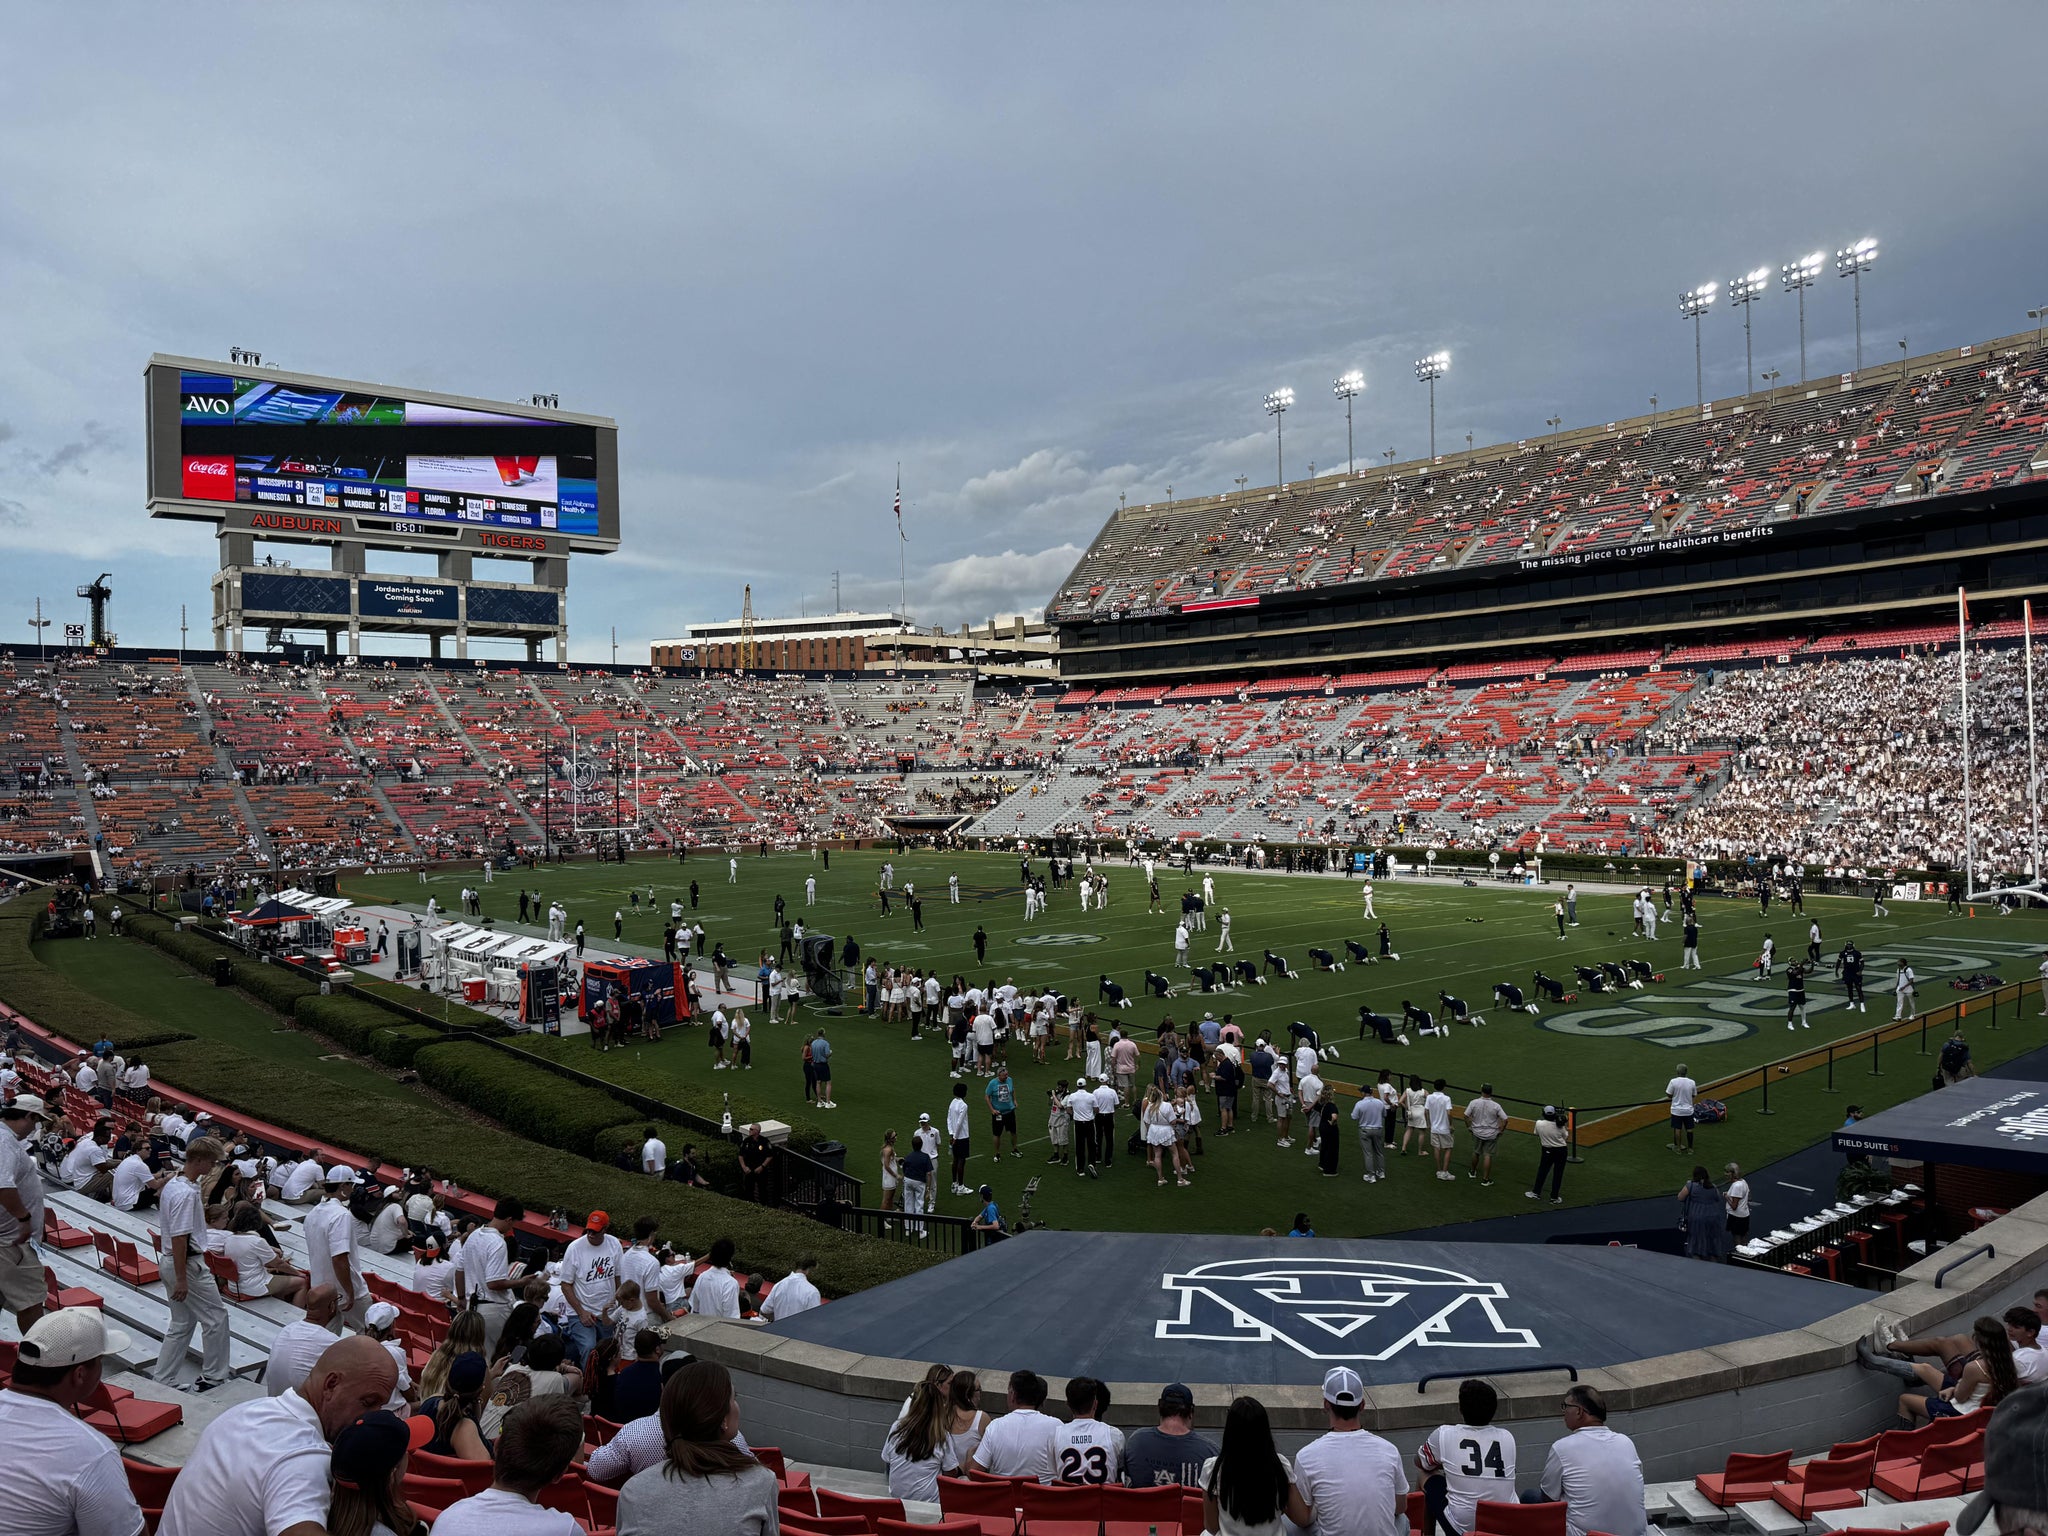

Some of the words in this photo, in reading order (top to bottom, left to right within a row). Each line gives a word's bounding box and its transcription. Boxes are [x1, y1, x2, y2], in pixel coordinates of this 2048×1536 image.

[186, 395, 230, 415] AVO
[257, 477, 286, 488] MISSISSIPPI
[286, 480, 294, 489] ST
[295, 480, 304, 491] 31
[308, 486, 323, 495] 12:37
[343, 486, 373, 496] DELAWARE
[379, 489, 387, 498] 17
[257, 491, 291, 502] MINNESOTA
[295, 494, 304, 504] 13
[424, 494, 451, 504] CAMPBELL
[459, 497, 464, 506] 3
[343, 499, 376, 510] VANDERBILT
[380, 502, 388, 512] 21
[501, 502, 528, 512] TENNESSEE
[561, 506, 580, 514] Health
[573, 501, 595, 509] Alabama
[424, 507, 447, 516] FLORIDA
[457, 510, 466, 519] 24
[251, 513, 342, 534] AUBURN
[501, 515, 520, 524] GEORGIA
[520, 517, 532, 525] TECH
[479, 533, 546, 551] TIGERS
[1520, 559, 1539, 570] The
[1541, 554, 1581, 568] missing
[1584, 550, 1612, 563] piece
[1615, 548, 1627, 557] to
[1630, 544, 1656, 556] your
[1658, 534, 1720, 551] healthcare
[1723, 526, 1774, 542] benefits
[374, 584, 420, 596] Jordan-Hare
[422, 587, 445, 596] North
[384, 594, 414, 604] Coming
[415, 594, 435, 603] Soon
[66, 625, 83, 636] 25
[683, 650, 694, 660] 25
[1838, 1138, 1862, 1149] FIELD
[1863, 1141, 1890, 1151] SUITE
[591, 1256, 611, 1270] WAR
[1071, 1435, 1093, 1444] OKORO
[1459, 1438, 1506, 1478] 34
[1060, 1446, 1109, 1485] 23
